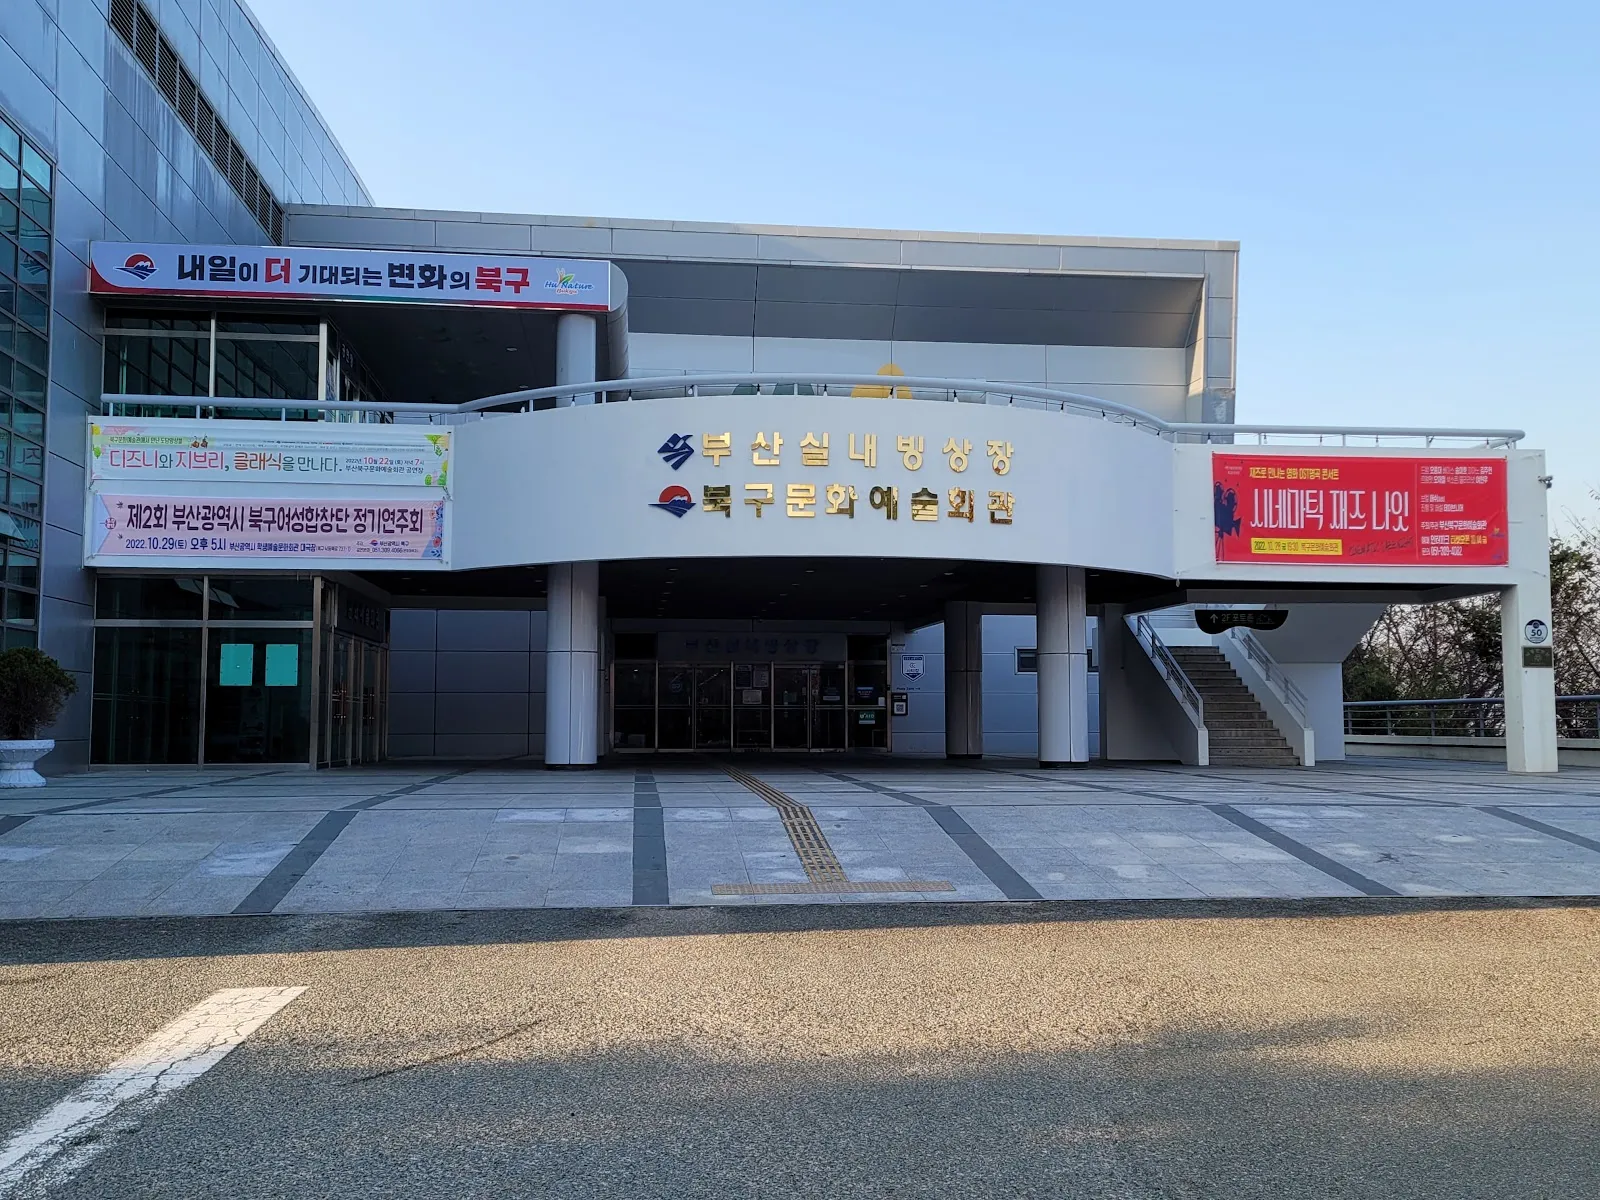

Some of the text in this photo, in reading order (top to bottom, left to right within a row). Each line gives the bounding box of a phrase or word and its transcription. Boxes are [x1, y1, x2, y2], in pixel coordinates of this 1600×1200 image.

[178, 254, 530, 294] 내일이 더 기대되는 변화의 북구
[544, 280, 594, 291] Hu Nature
[701, 430, 1014, 475] 부산실내빙상장
[110, 450, 342, 472] 디즈니와 지브리, 클래식을 만나다.
[364, 457, 378, 465] 10월
[345, 465, 424, 474] 부산북구문화예술회관 공연장
[1249, 467, 1267, 479] 재즈로
[1268, 467, 1285, 479] 만나는
[1286, 468, 1298, 480] 영화
[1322, 468, 1340, 481] 콘서트
[702, 482, 1016, 525] 북구문화예술회관
[1250, 488, 1409, 532] 시네마틱 재즈 나잇
[126, 503, 168, 530] 제2회
[172, 505, 245, 532] 부산광역시
[248, 506, 350, 534] 북구여성합창단
[353, 508, 423, 534] 정기연주회
[190, 538, 208, 551] 오후
[211, 538, 226, 551] 5시
[229, 542, 256, 551] 부산광역시
[1531, 629, 1542, 637] 50
